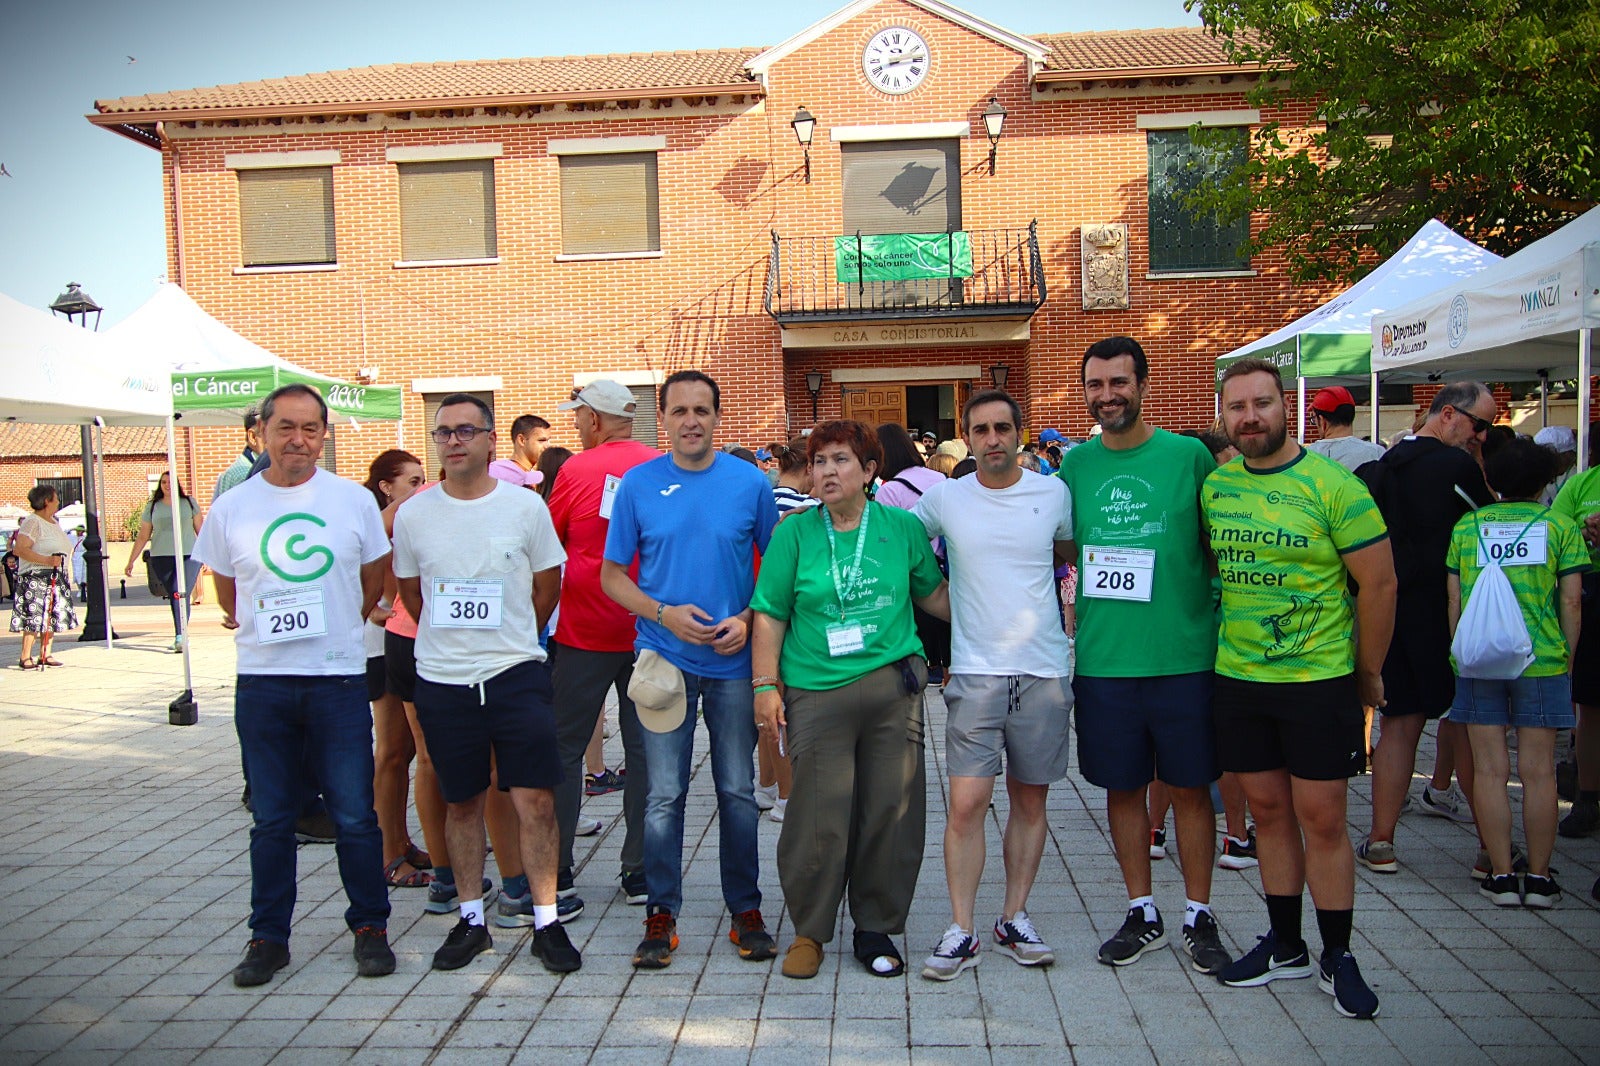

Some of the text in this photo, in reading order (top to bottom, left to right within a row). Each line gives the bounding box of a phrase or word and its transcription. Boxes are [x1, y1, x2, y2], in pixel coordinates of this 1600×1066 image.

[874, 252, 882, 260] el
[884, 251, 914, 260] cáncer
[875, 260, 892, 268] solo
[1520, 284, 1560, 314] AVANZA
[833, 326, 978, 342] CASA CONSISTORIAL
[194, 376, 259, 396] Cáncer
[328, 384, 366, 410] aecc
[1221, 527, 1309, 549] marcha
[1490, 541, 1529, 559] 086
[1096, 570, 1135, 591] 208
[1220, 565, 1288, 587] cáncer
[449, 600, 489, 620] 380
[269, 610, 309, 634] 290
